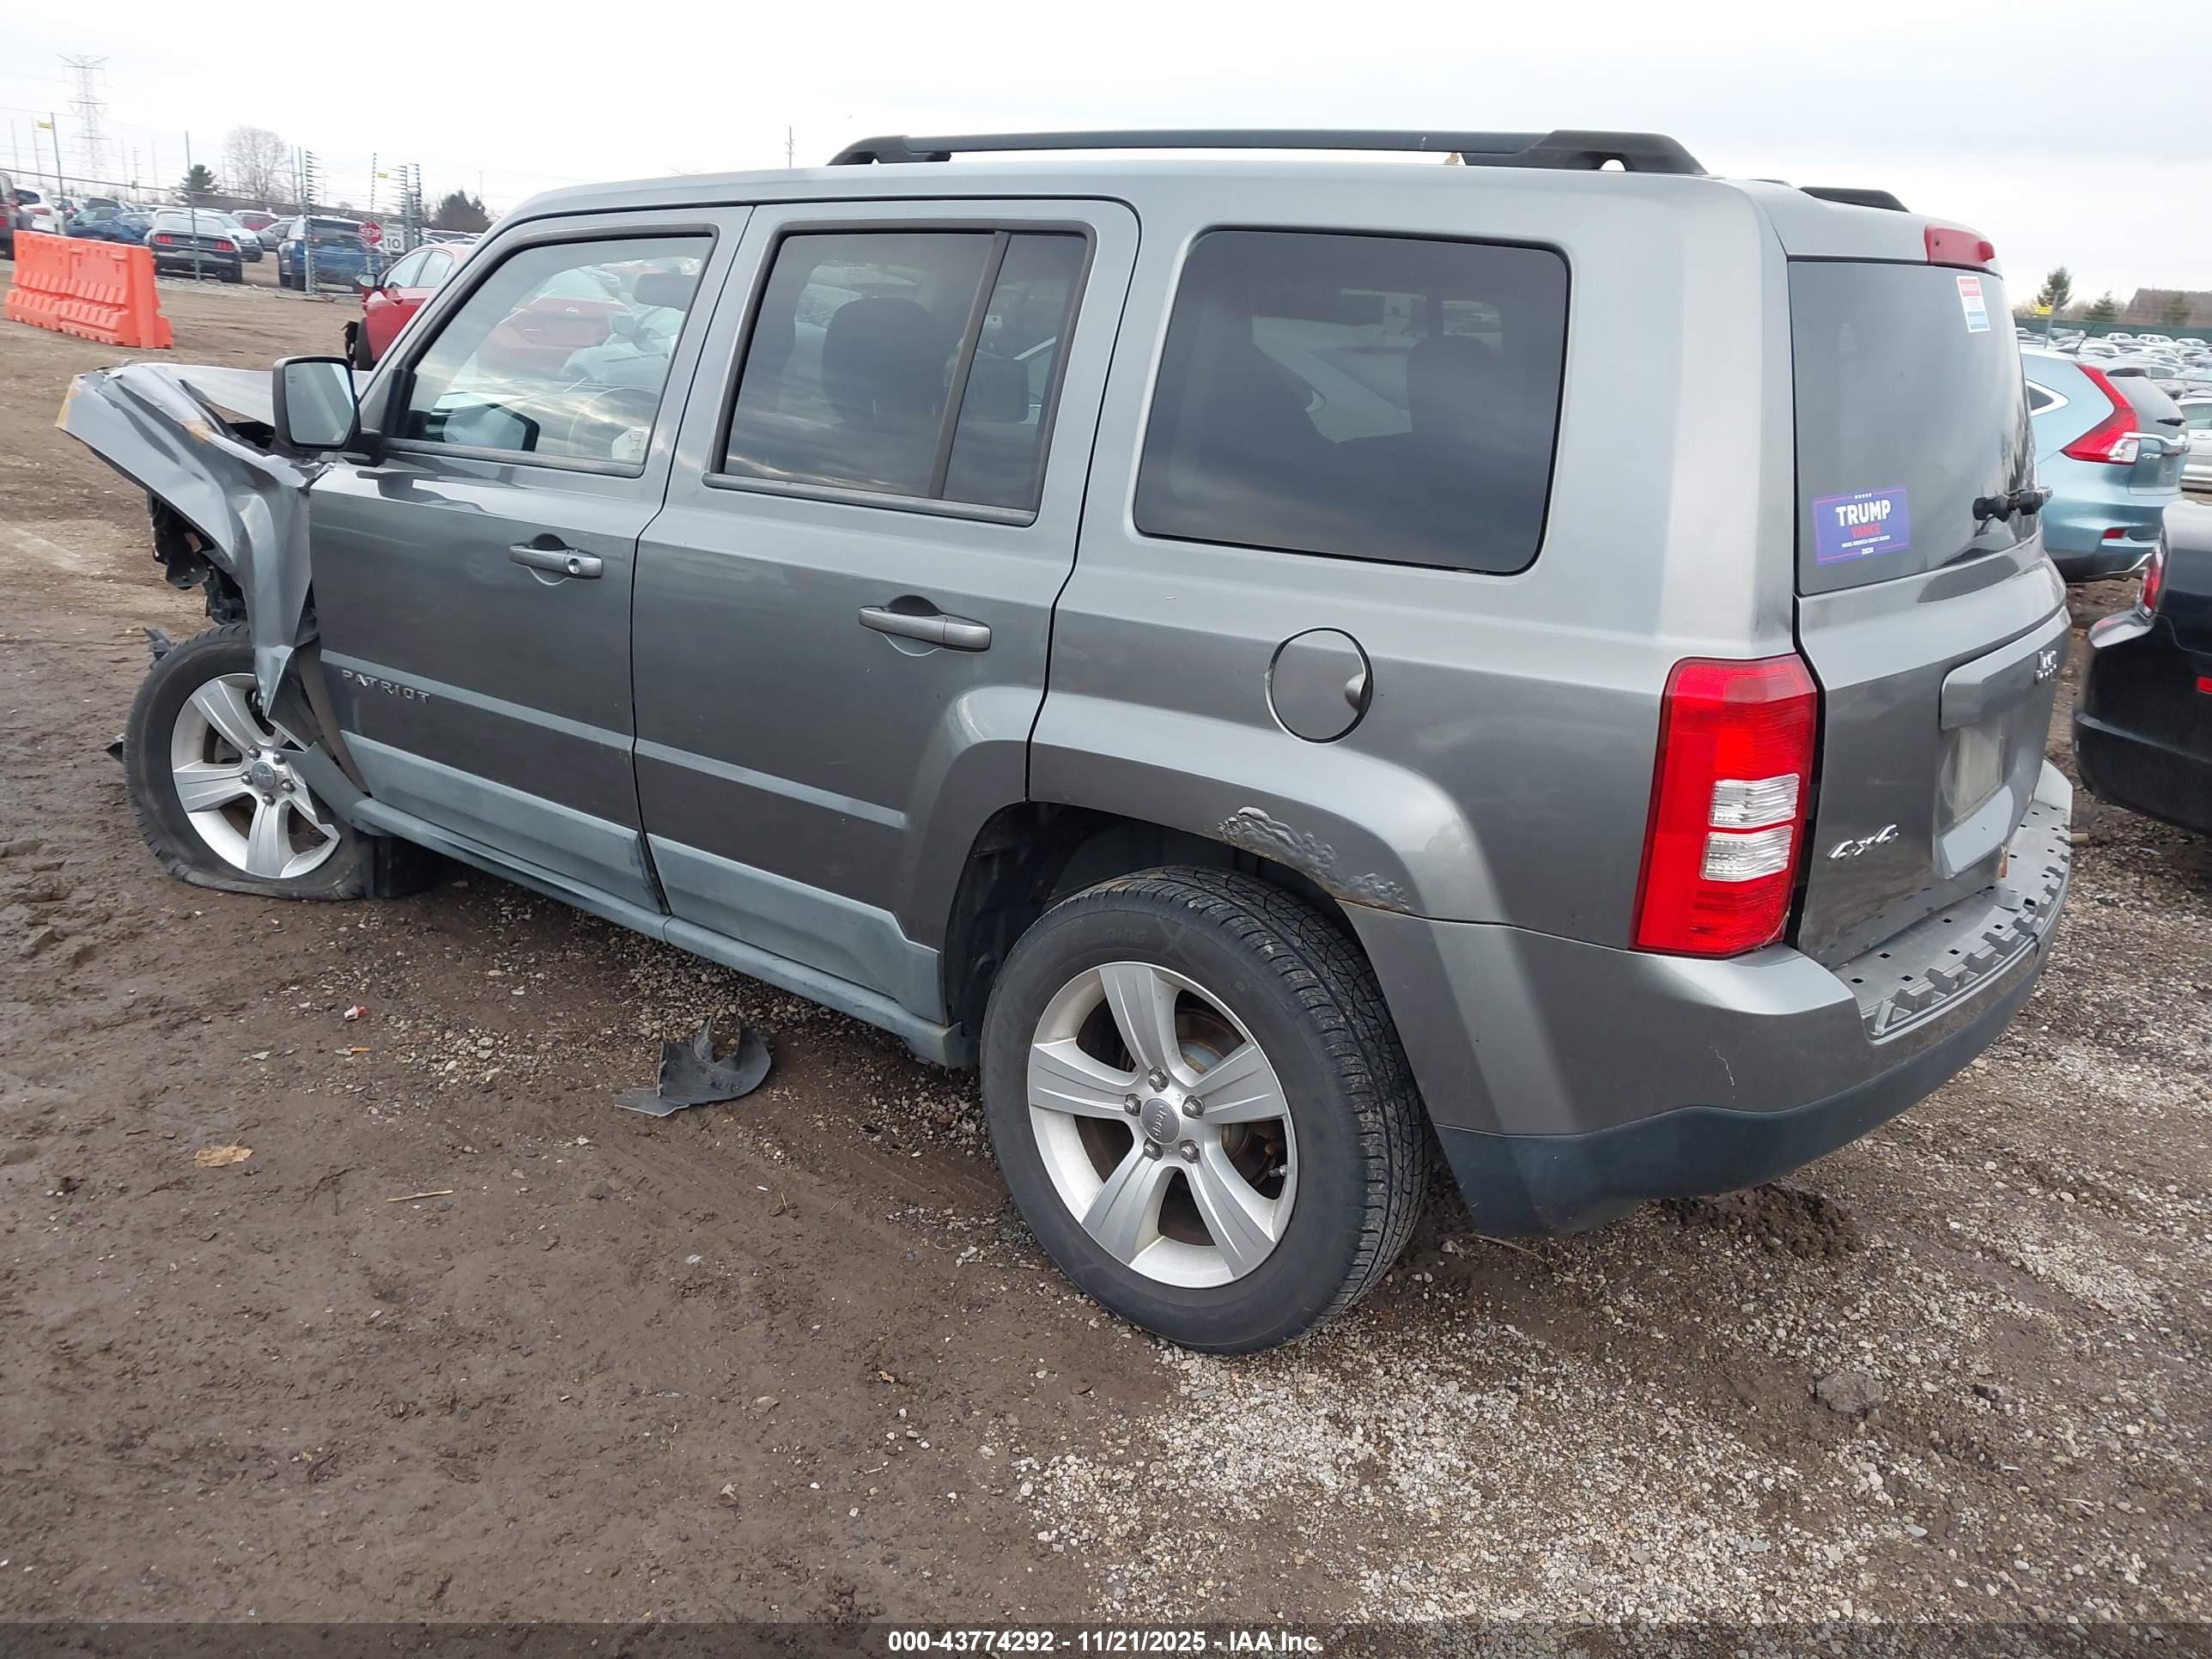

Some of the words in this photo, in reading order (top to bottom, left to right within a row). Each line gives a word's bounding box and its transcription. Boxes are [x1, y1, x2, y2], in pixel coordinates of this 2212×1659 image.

[386, 238, 401, 250] 10
[1835, 499, 1891, 527] TRUMP
[342, 669, 430, 704] PATRIOT
[1152, 1105, 1169, 1137] Jeep
